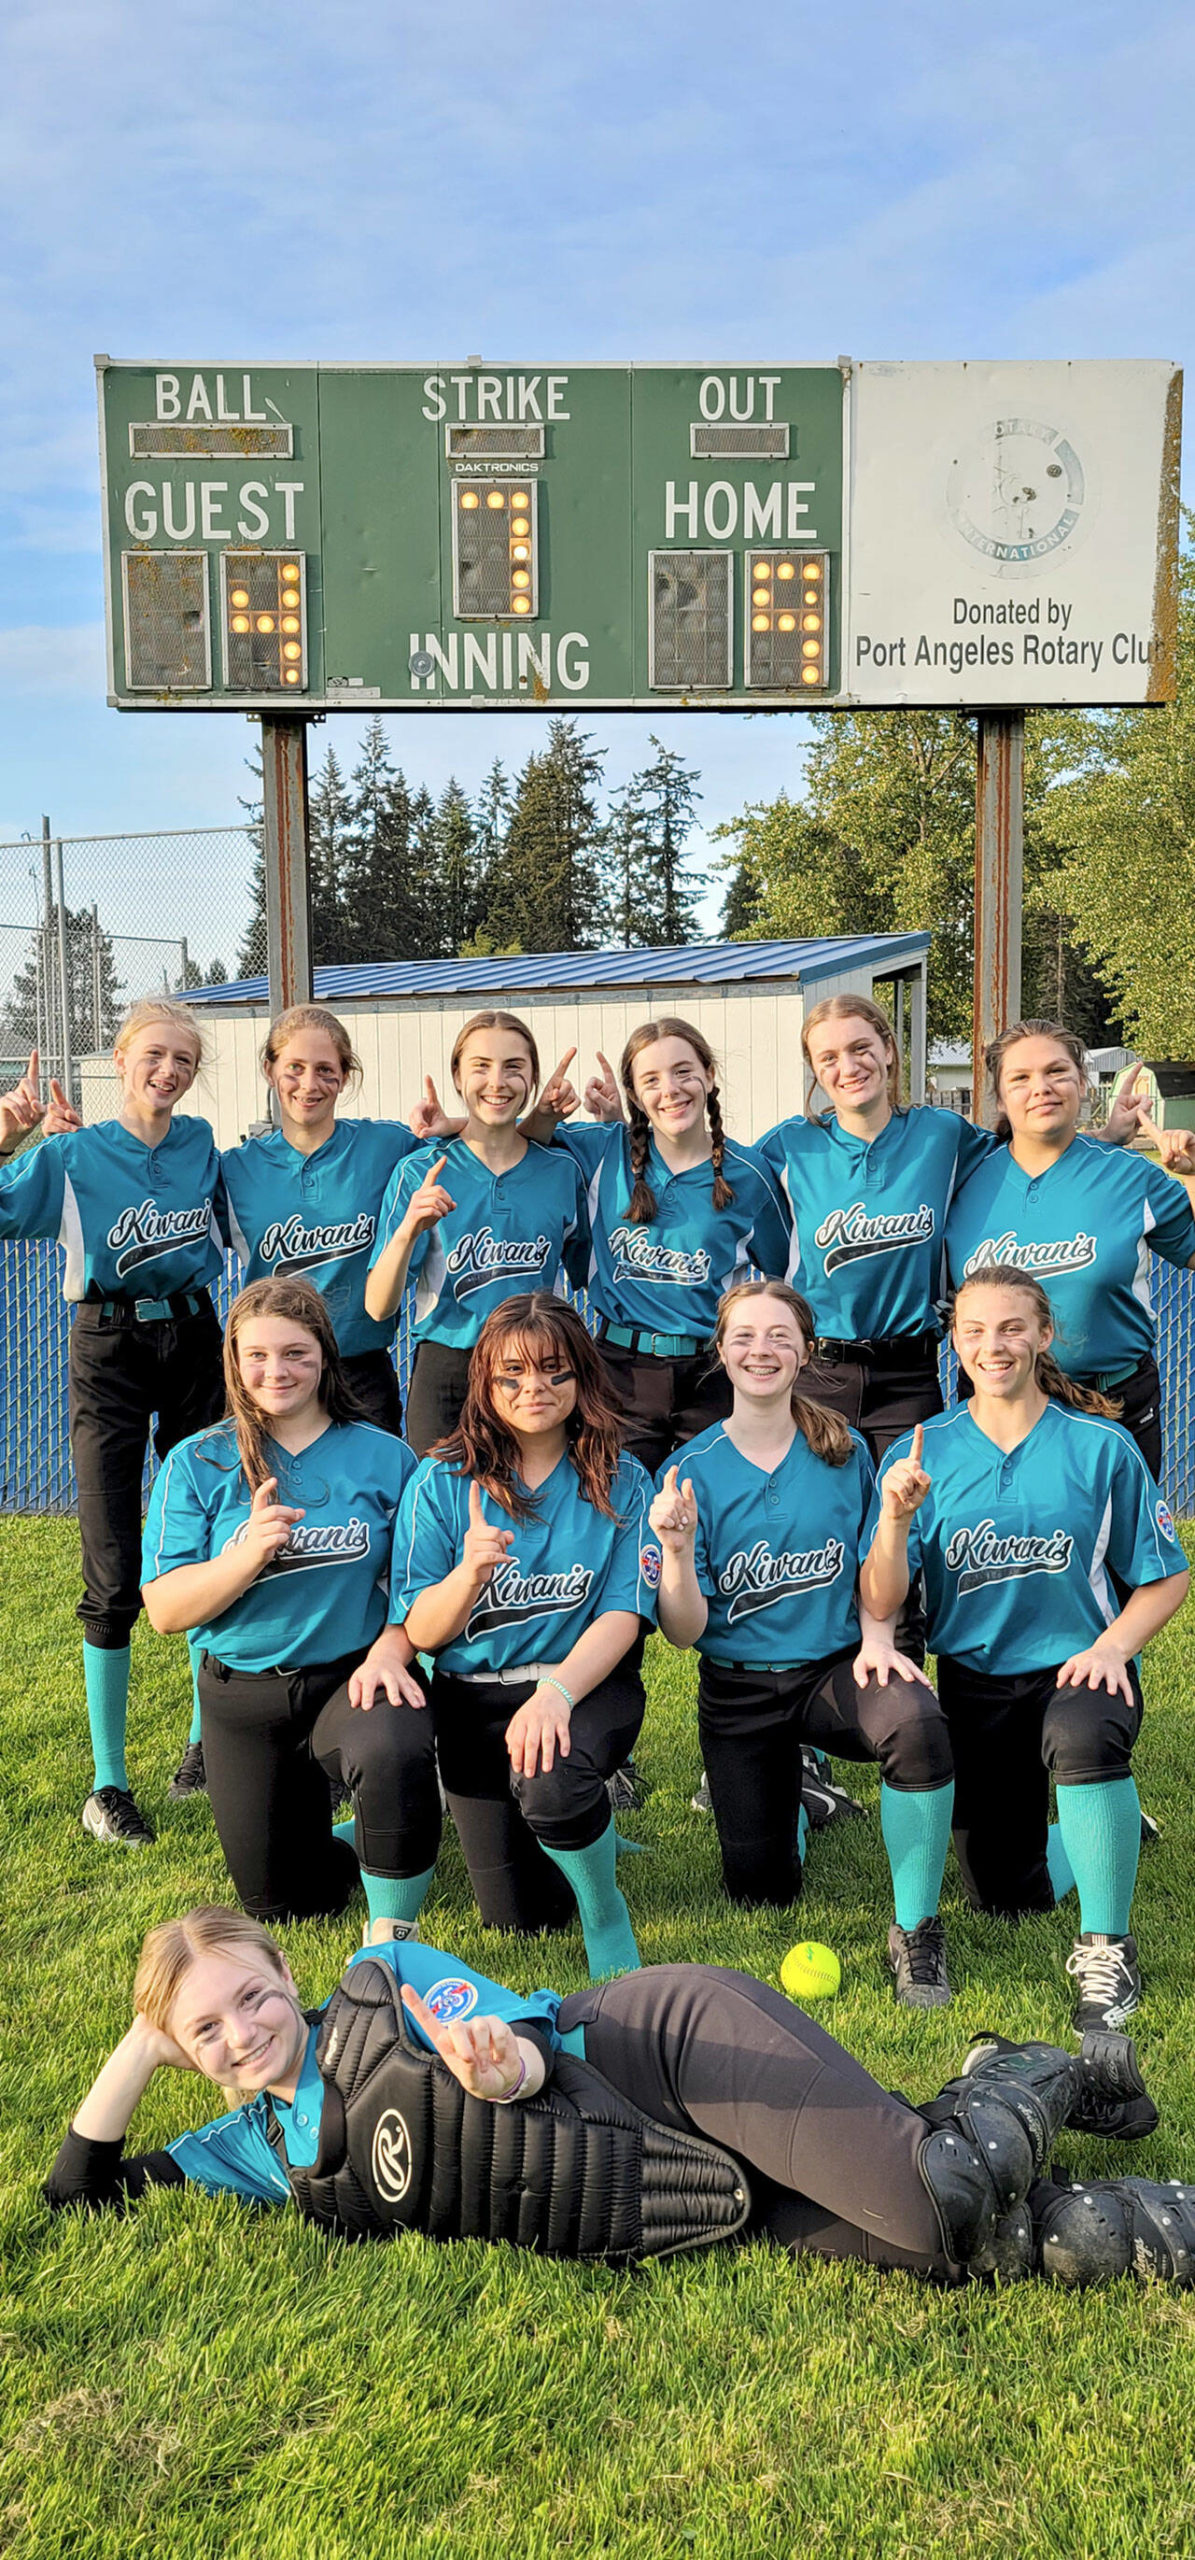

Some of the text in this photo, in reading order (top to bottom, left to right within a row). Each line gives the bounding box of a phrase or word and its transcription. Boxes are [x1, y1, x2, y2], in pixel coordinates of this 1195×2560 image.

[156, 374, 267, 421] BALL
[421, 376, 571, 421] STRIKE
[699, 376, 781, 421] OUT
[455, 462, 539, 473] DAKTRONICS
[124, 481, 305, 541] GUEST
[665, 481, 818, 540] HOME
[953, 598, 1072, 630] Donated by
[409, 631, 590, 691] INNING
[856, 635, 906, 667] Port
[914, 635, 1014, 674] Angeles
[1023, 635, 1104, 673] Rotary
[107, 1198, 211, 1250] Kiwani
[259, 1213, 376, 1261] Kiwanis
[815, 1202, 934, 1250] Kiwanis
[608, 1227, 711, 1276] Kiwanis
[963, 1231, 1097, 1279] Kiwanis
[719, 1538, 844, 1595] Kiwanis
[945, 1518, 1074, 1571] Kiwanis
